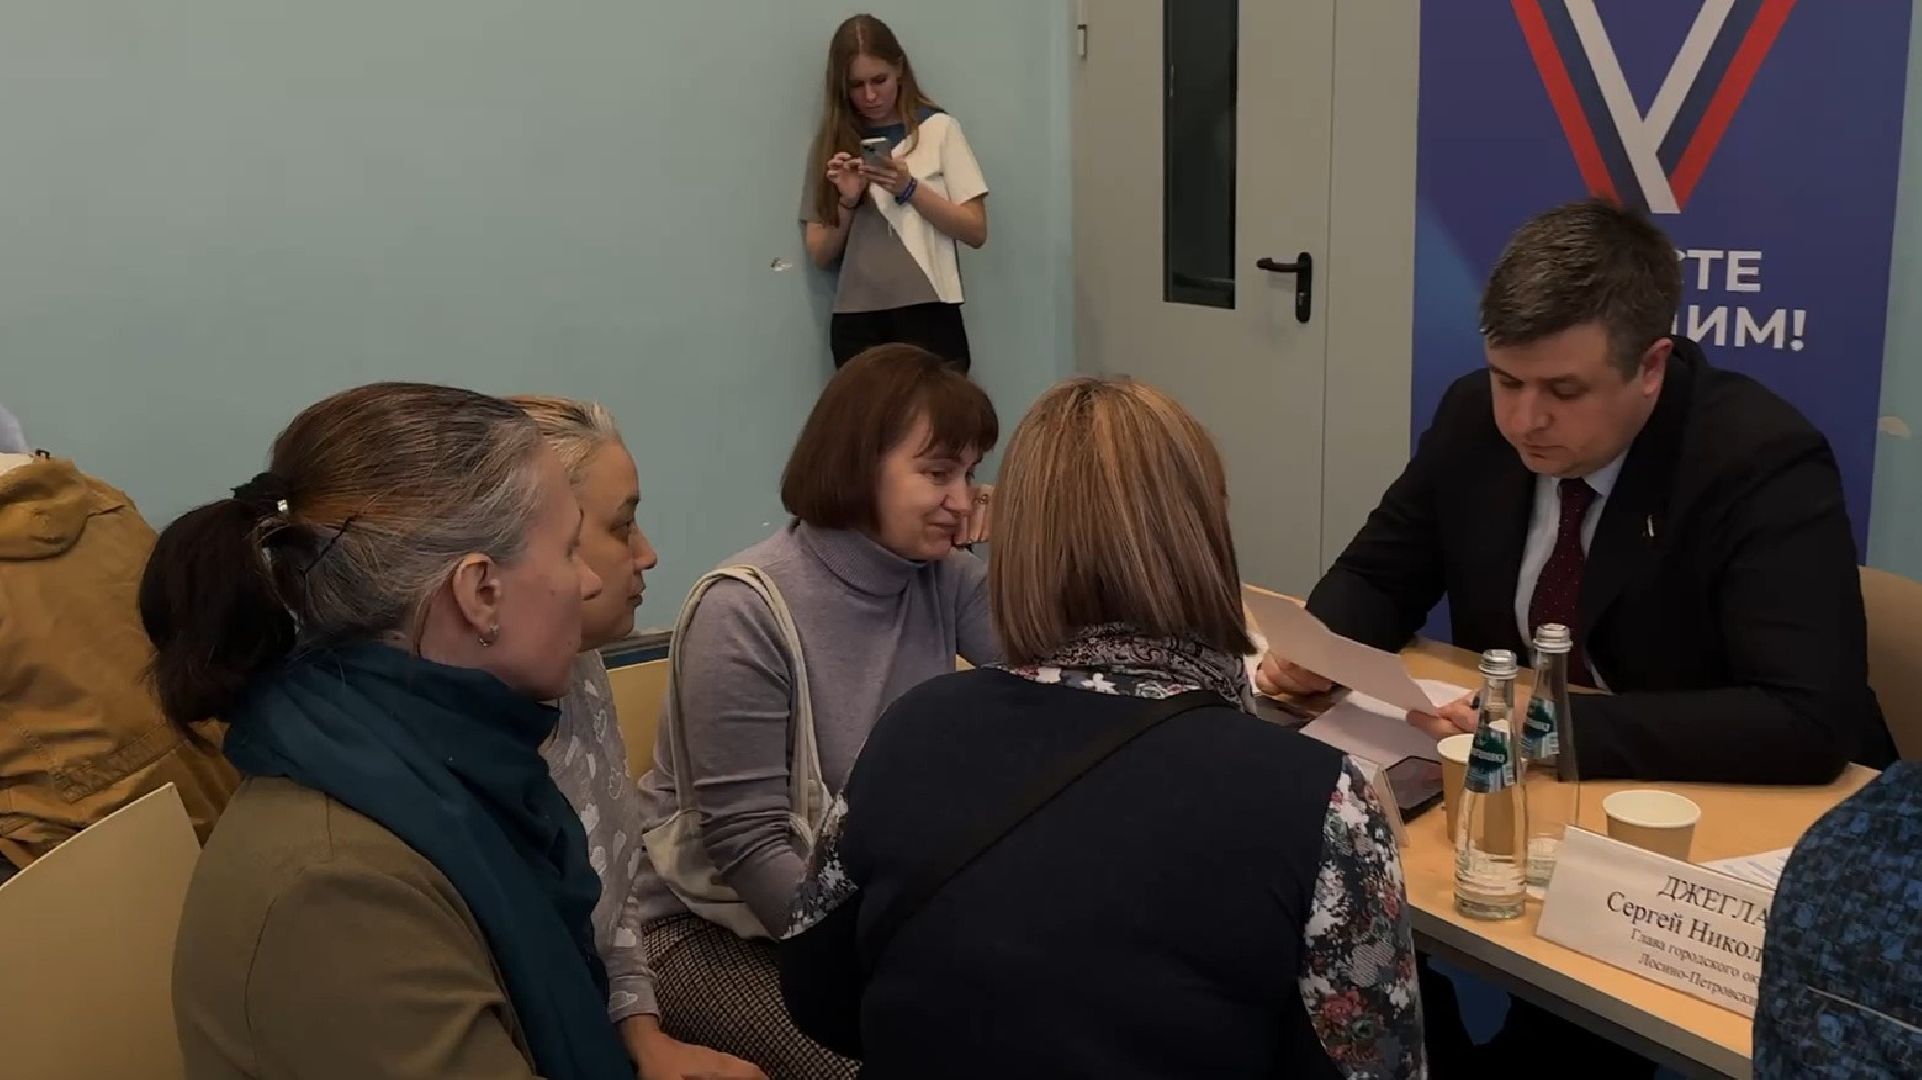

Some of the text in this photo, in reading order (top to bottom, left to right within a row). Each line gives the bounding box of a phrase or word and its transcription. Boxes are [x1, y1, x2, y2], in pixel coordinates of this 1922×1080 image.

[1674, 249, 1762, 292] ТЕ
[1671, 305, 1807, 351] ИМ!
[1607, 891, 1682, 934] Сергей
[1630, 928, 1666, 951] Глава
[1668, 944, 1740, 977] городского
